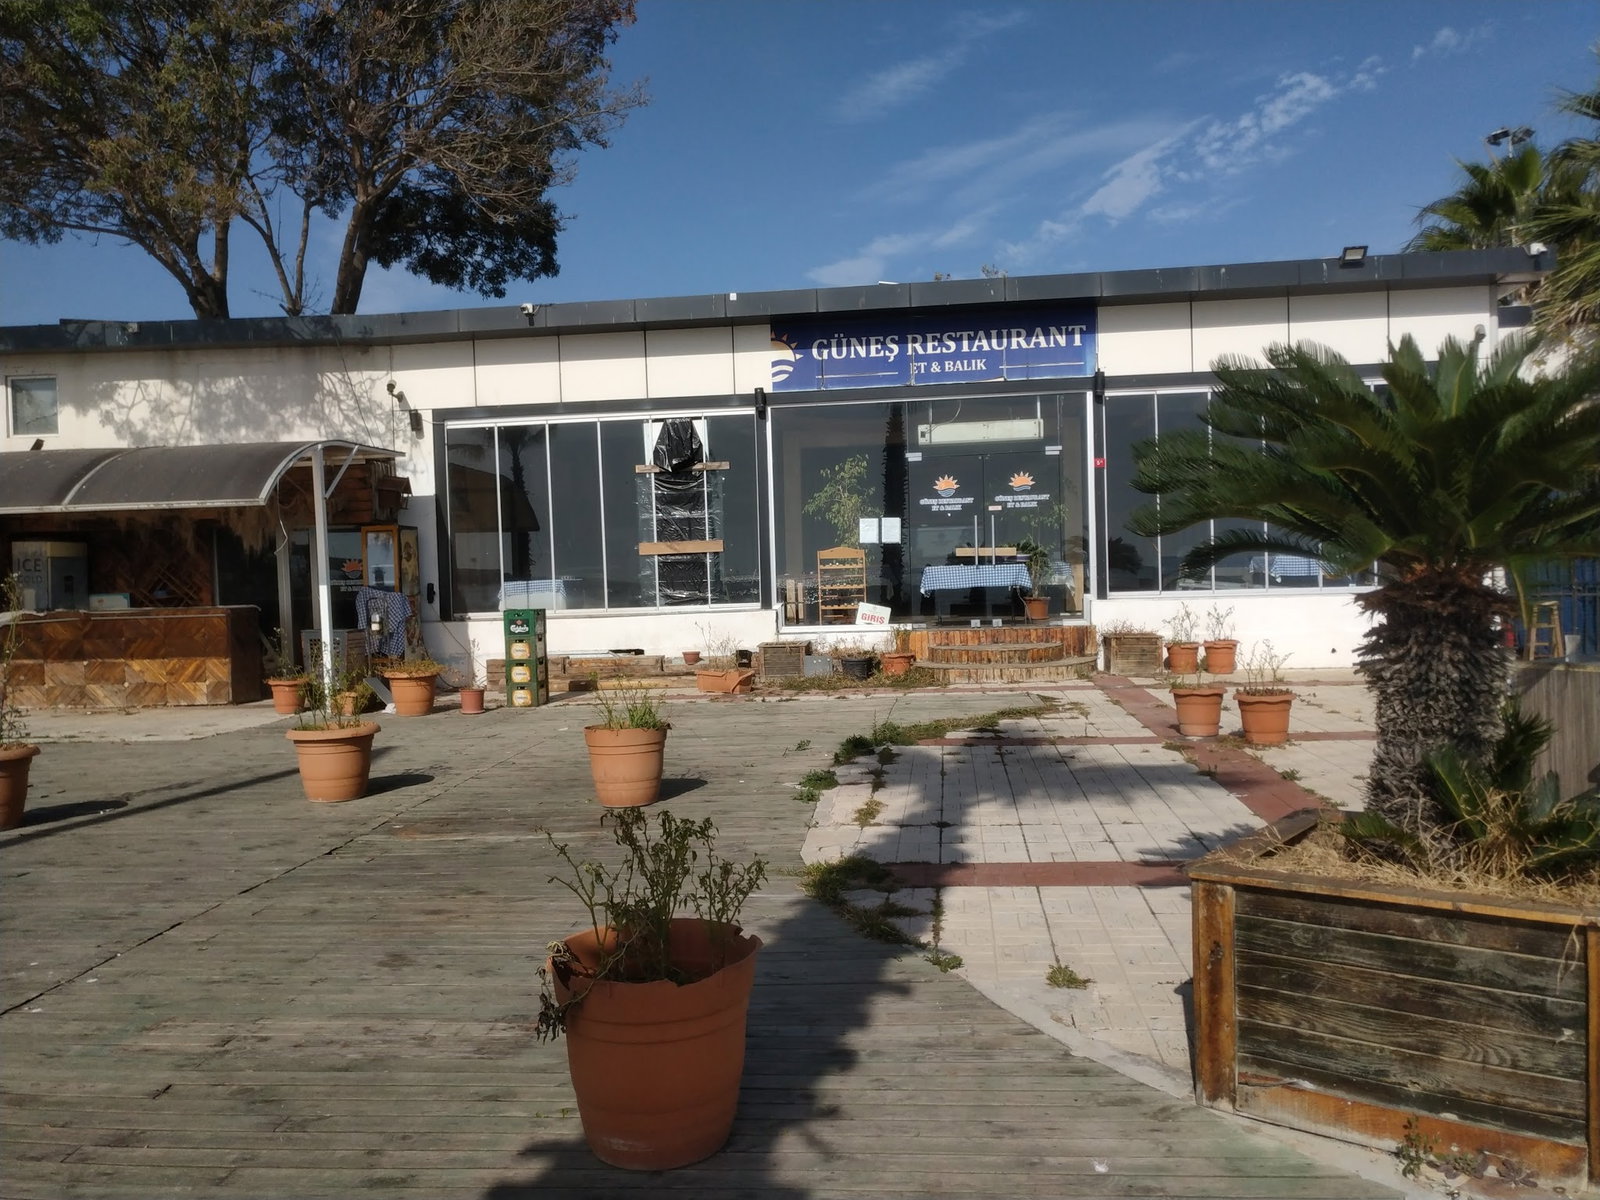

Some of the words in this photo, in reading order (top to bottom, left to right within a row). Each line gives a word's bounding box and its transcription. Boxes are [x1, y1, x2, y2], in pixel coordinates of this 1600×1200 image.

[811, 333, 899, 362] GÜNEŞ
[906, 324, 1087, 356] RESTAURANT
[910, 362, 927, 374] ET
[930, 361, 941, 373] &
[944, 358, 987, 373] BALIK
[17, 558, 41, 572] ICE
